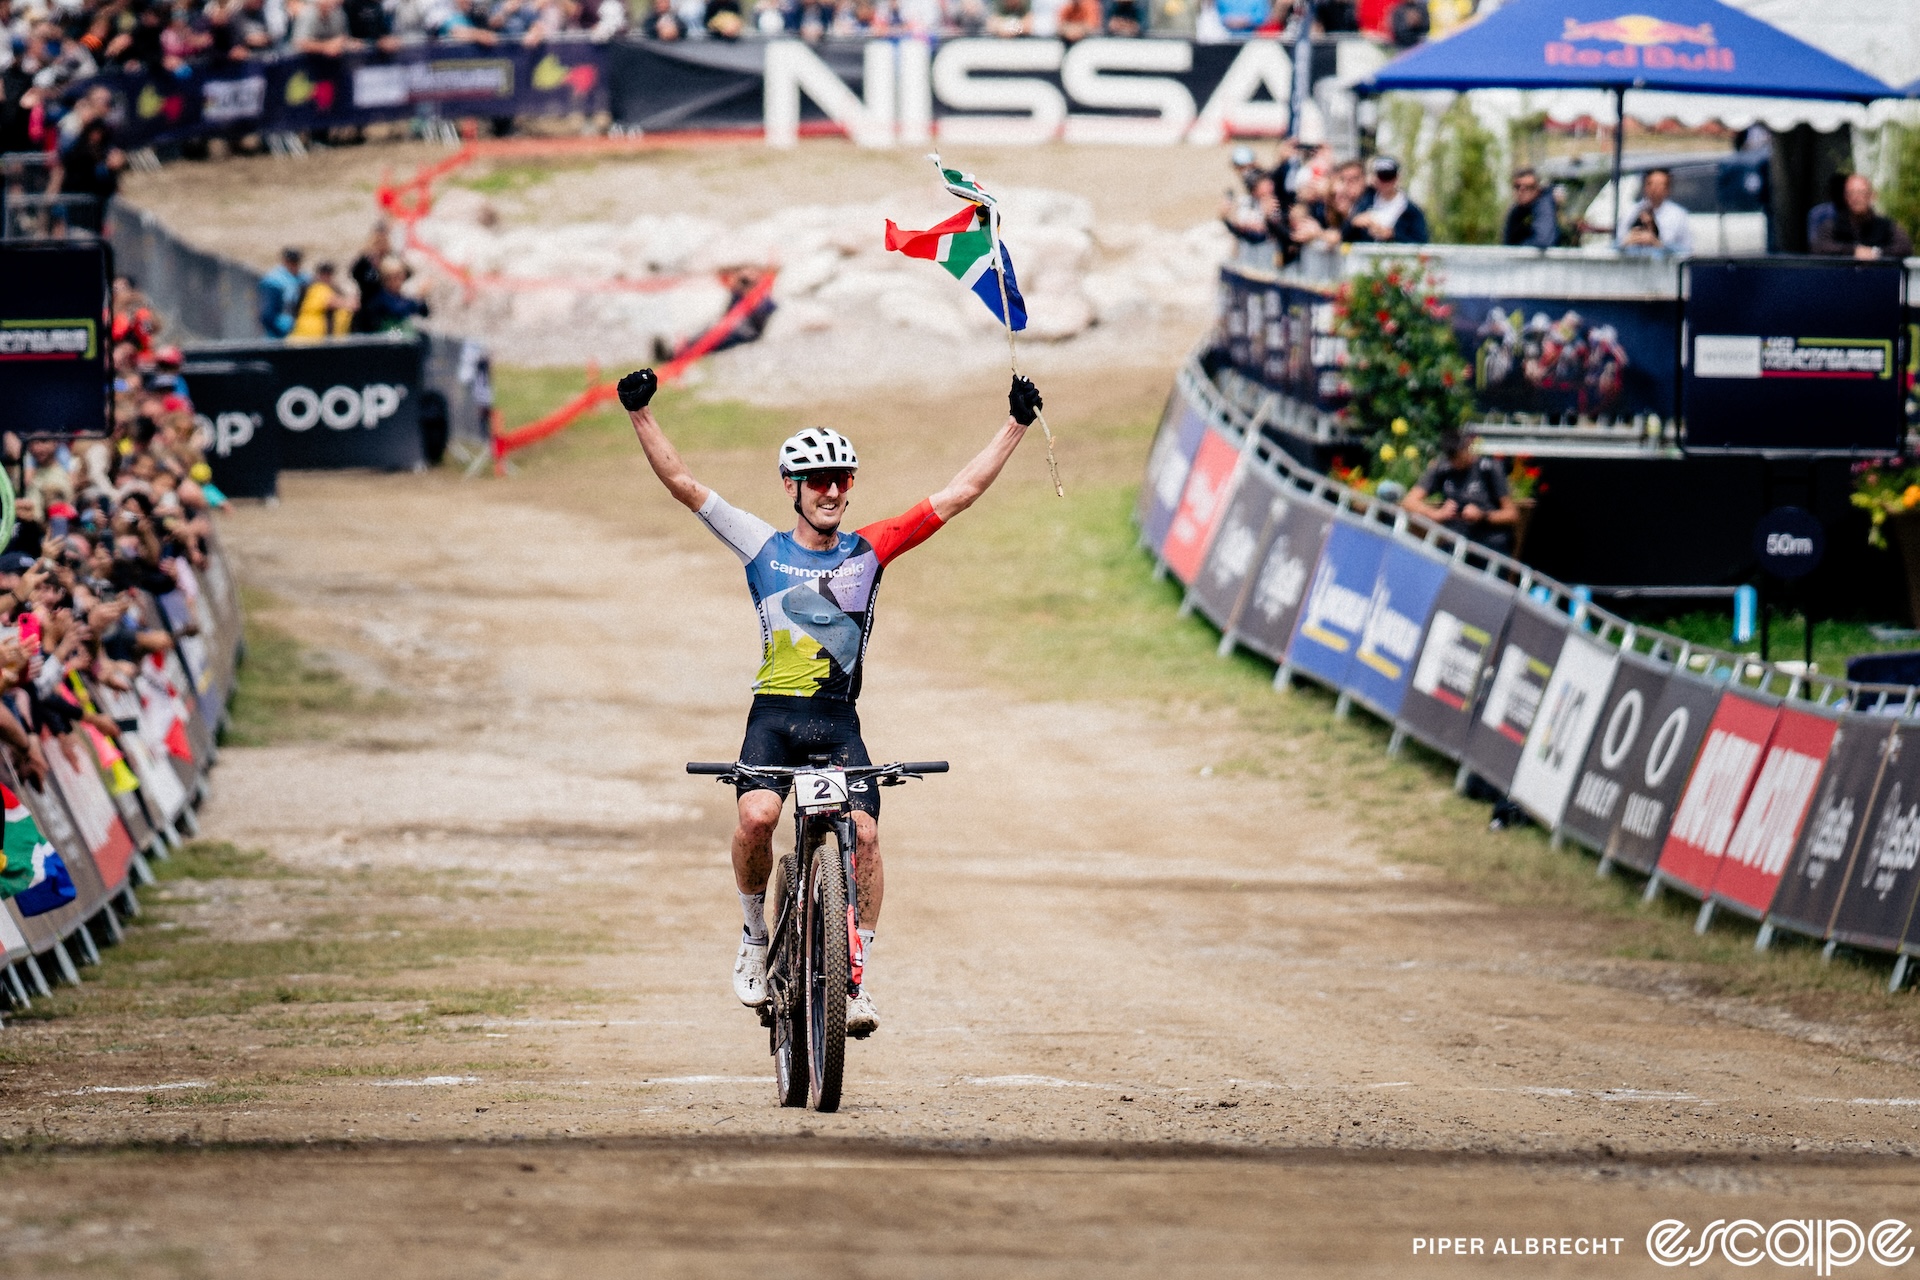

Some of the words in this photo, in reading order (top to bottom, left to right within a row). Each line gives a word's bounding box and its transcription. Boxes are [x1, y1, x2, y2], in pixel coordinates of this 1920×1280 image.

[1545, 42, 1638, 68] Red
[1643, 46, 1735, 73] Bull
[1766, 533, 1814, 556] 50m
[769, 559, 865, 579] cannondale
[813, 779, 832, 800] 2
